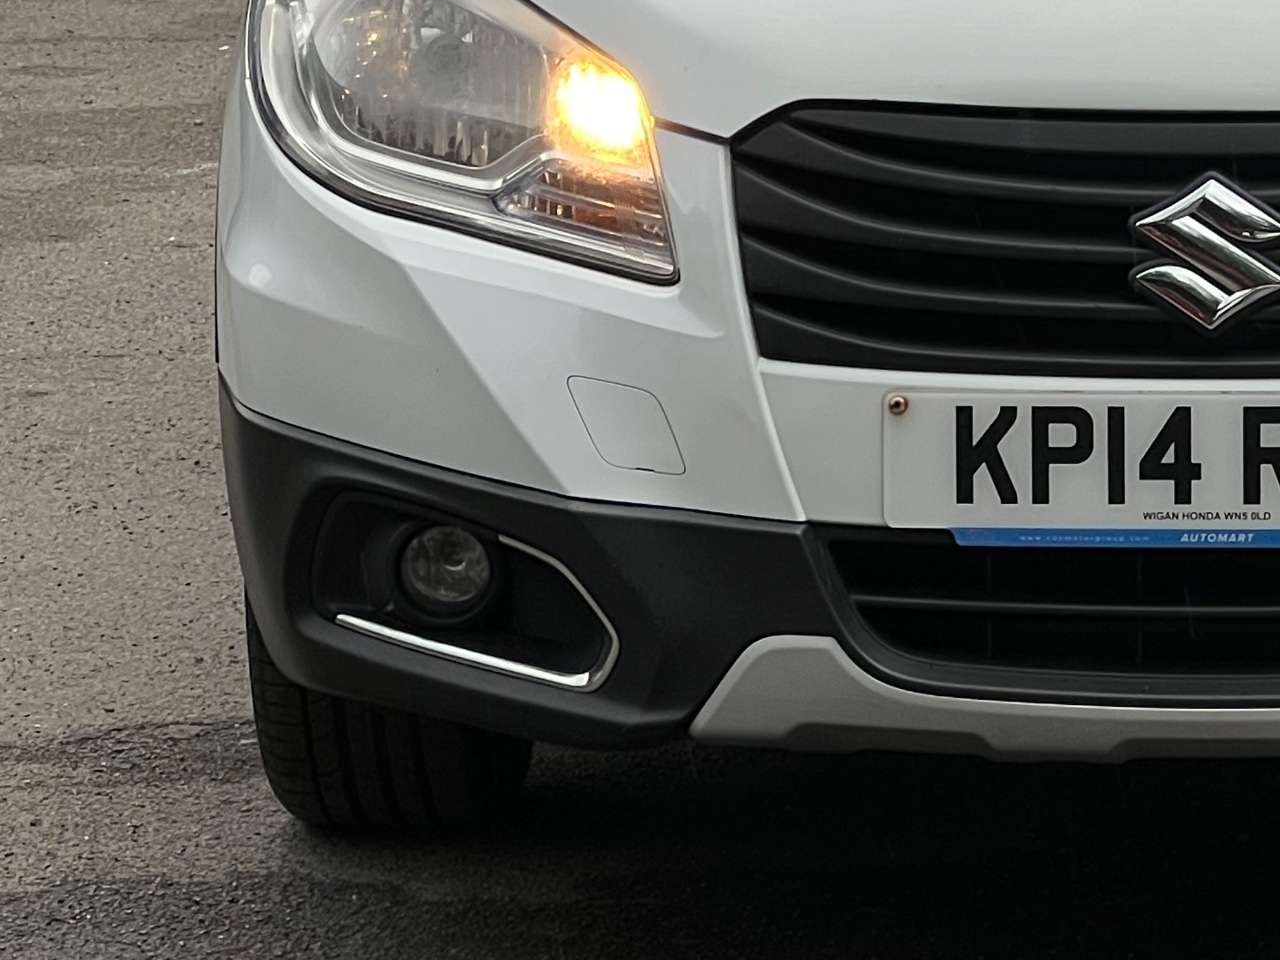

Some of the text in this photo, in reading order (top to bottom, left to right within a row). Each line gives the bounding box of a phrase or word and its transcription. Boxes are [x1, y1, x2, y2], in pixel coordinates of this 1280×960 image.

[955, 405, 1202, 505] KP14
[1142, 511, 1179, 521] WIGAN
[1182, 511, 1221, 521] HONDA
[1223, 511, 1248, 521] WN5
[1180, 533, 1256, 543] AUTOMART
